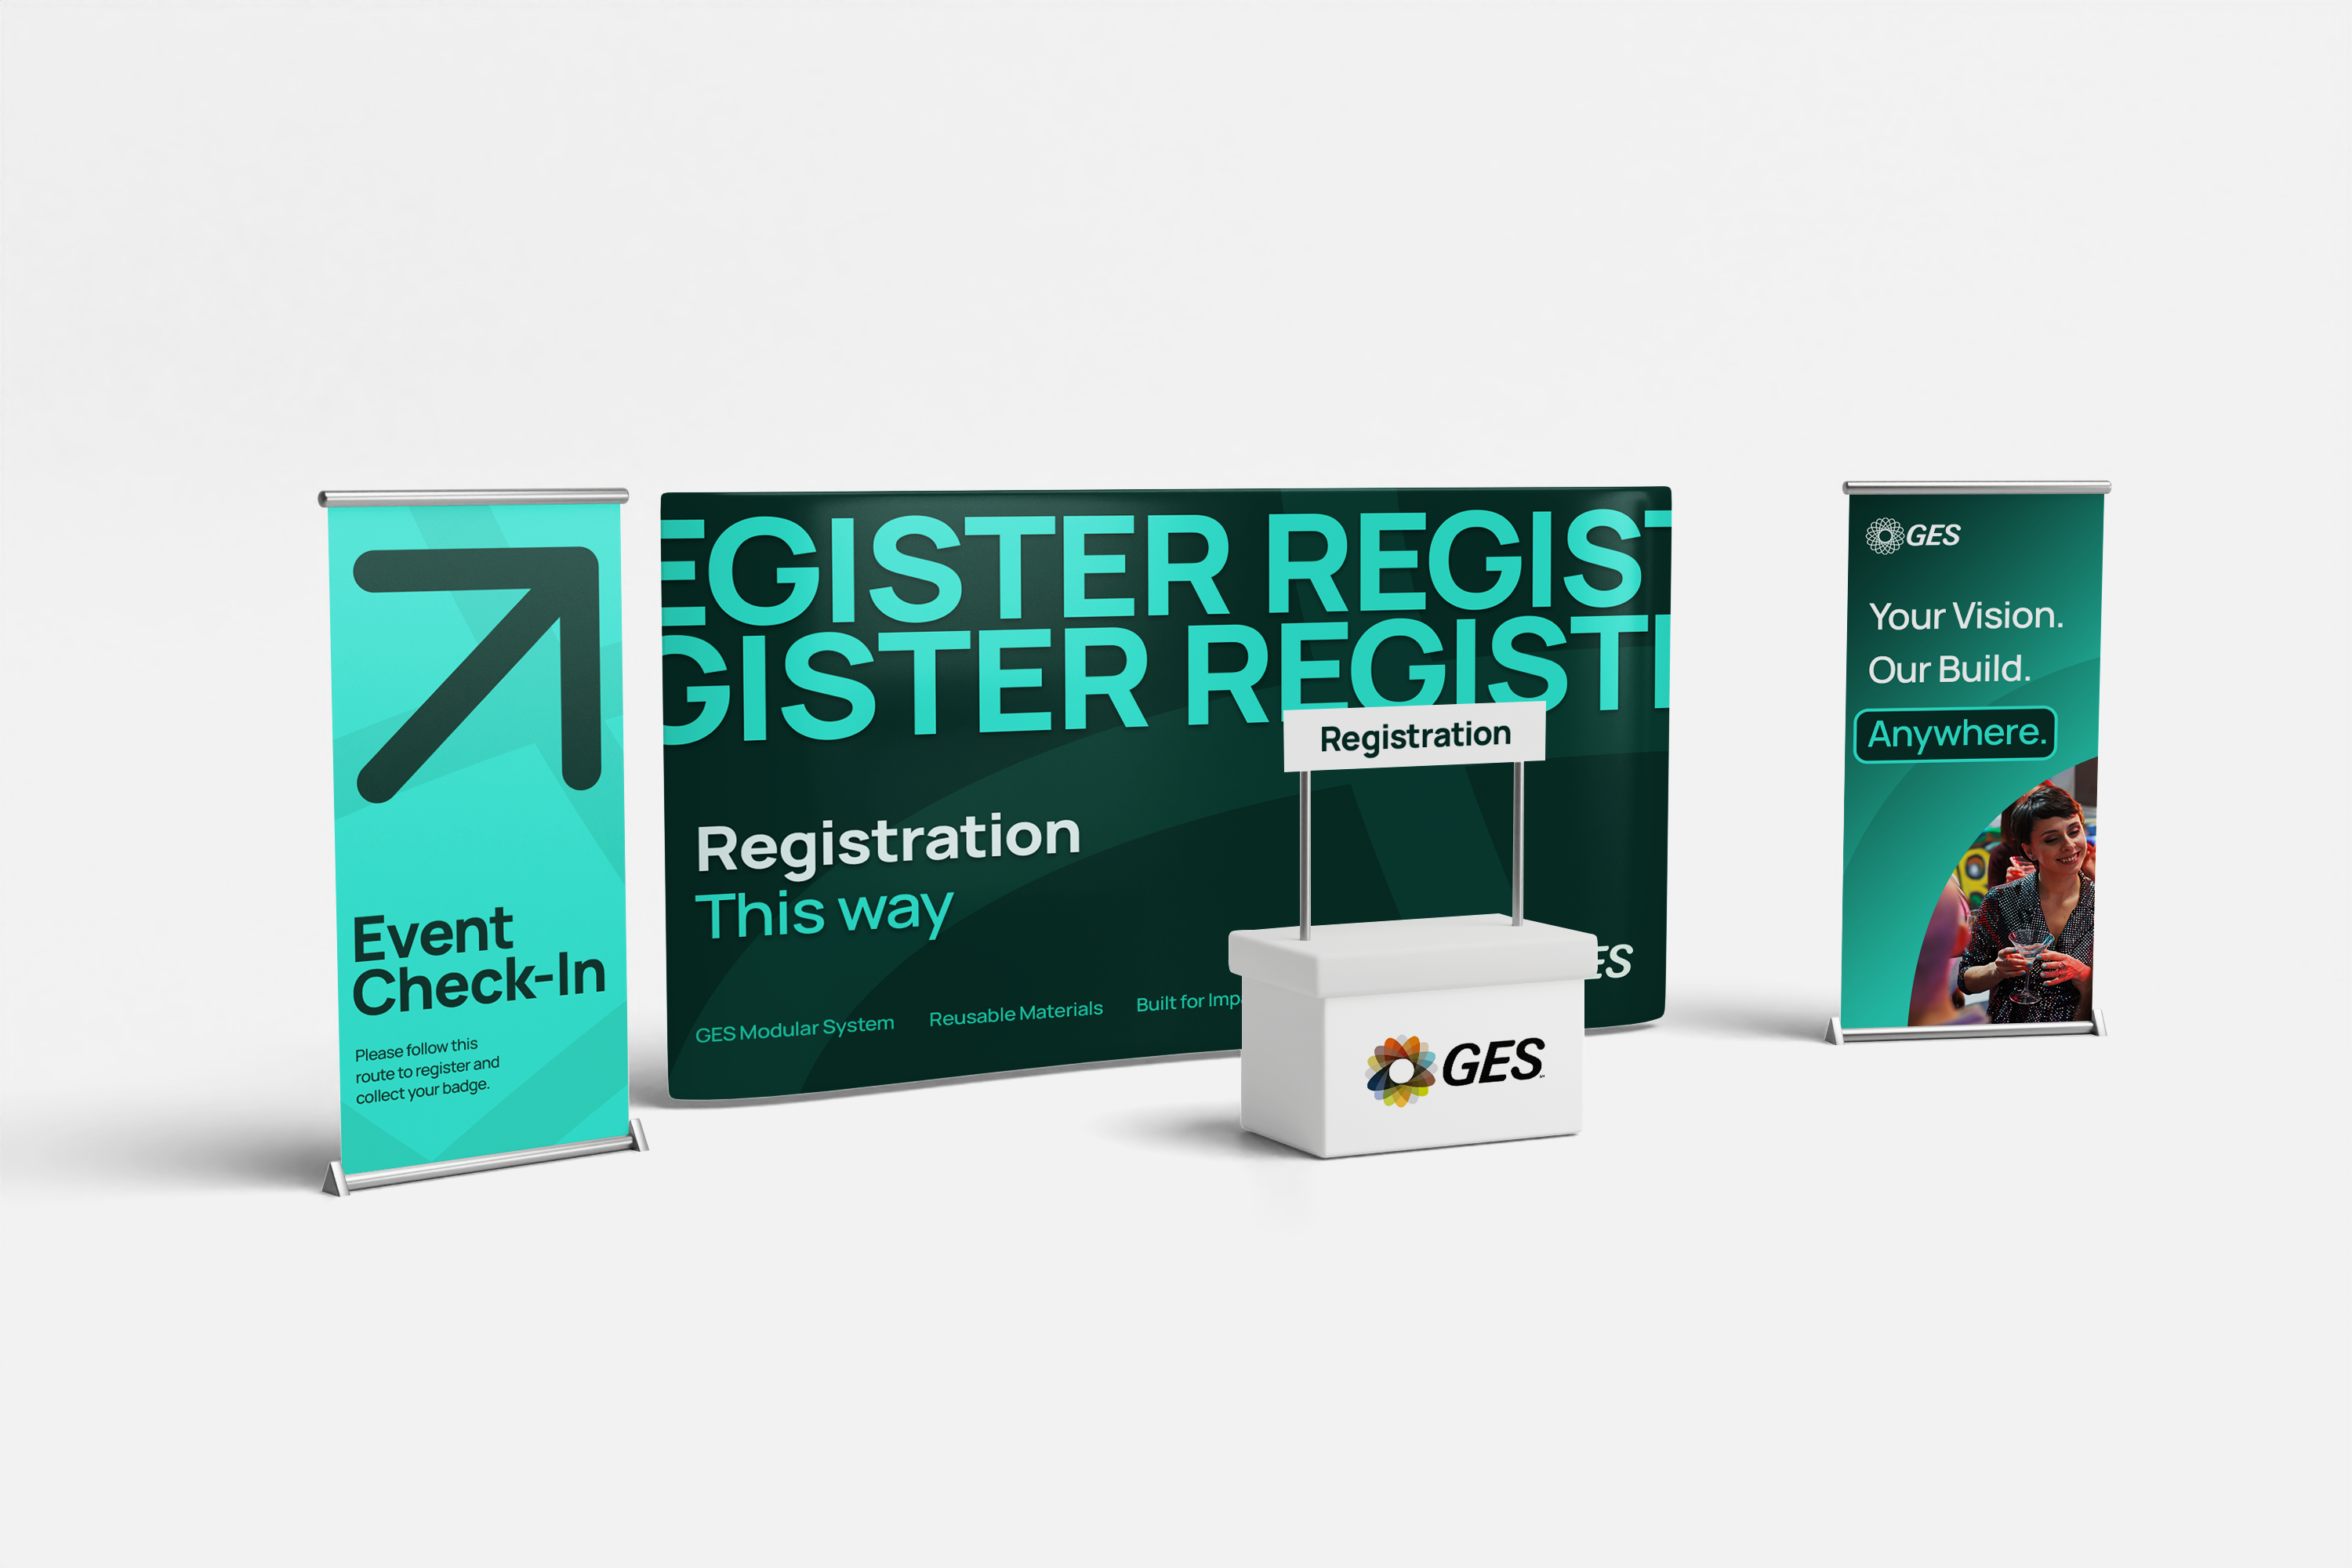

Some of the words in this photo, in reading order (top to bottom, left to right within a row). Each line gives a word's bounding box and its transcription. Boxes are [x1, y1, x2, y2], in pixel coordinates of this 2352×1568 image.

[1907, 524, 1961, 546] GES
[1870, 603, 1946, 630] Your
[1953, 601, 2063, 629] Vision.
[1188, 615, 1671, 725] REGIST
[1869, 656, 1931, 684] Our
[1940, 655, 2030, 682] Build.
[1322, 721, 1510, 758] Registration
[1868, 719, 2045, 755] Anywhere.
[699, 812, 1080, 881] Registration
[695, 890, 824, 938] This
[838, 892, 954, 940] way
[354, 907, 513, 962] Event
[354, 952, 604, 1015] Check-In
[931, 1007, 1015, 1026] Reusable
[1021, 1001, 1103, 1020] Materials
[1138, 996, 1177, 1011] Built
[1181, 995, 1204, 1008] for
[1210, 993, 1242, 1009] Imp
[696, 1026, 735, 1043] GES
[741, 1022, 819, 1040] Modular
[823, 1018, 894, 1037] System
[356, 1048, 403, 1062] Please
[406, 1043, 448, 1056] follow
[451, 1038, 477, 1051] this
[1443, 1038, 1544, 1086] GES
[357, 1069, 394, 1083] route
[397, 1067, 412, 1079] to
[416, 1062, 470, 1079] register
[474, 1056, 499, 1070] and
[357, 1088, 405, 1104] collect
[408, 1086, 440, 1102] your
[443, 1080, 489, 1094] badge.
